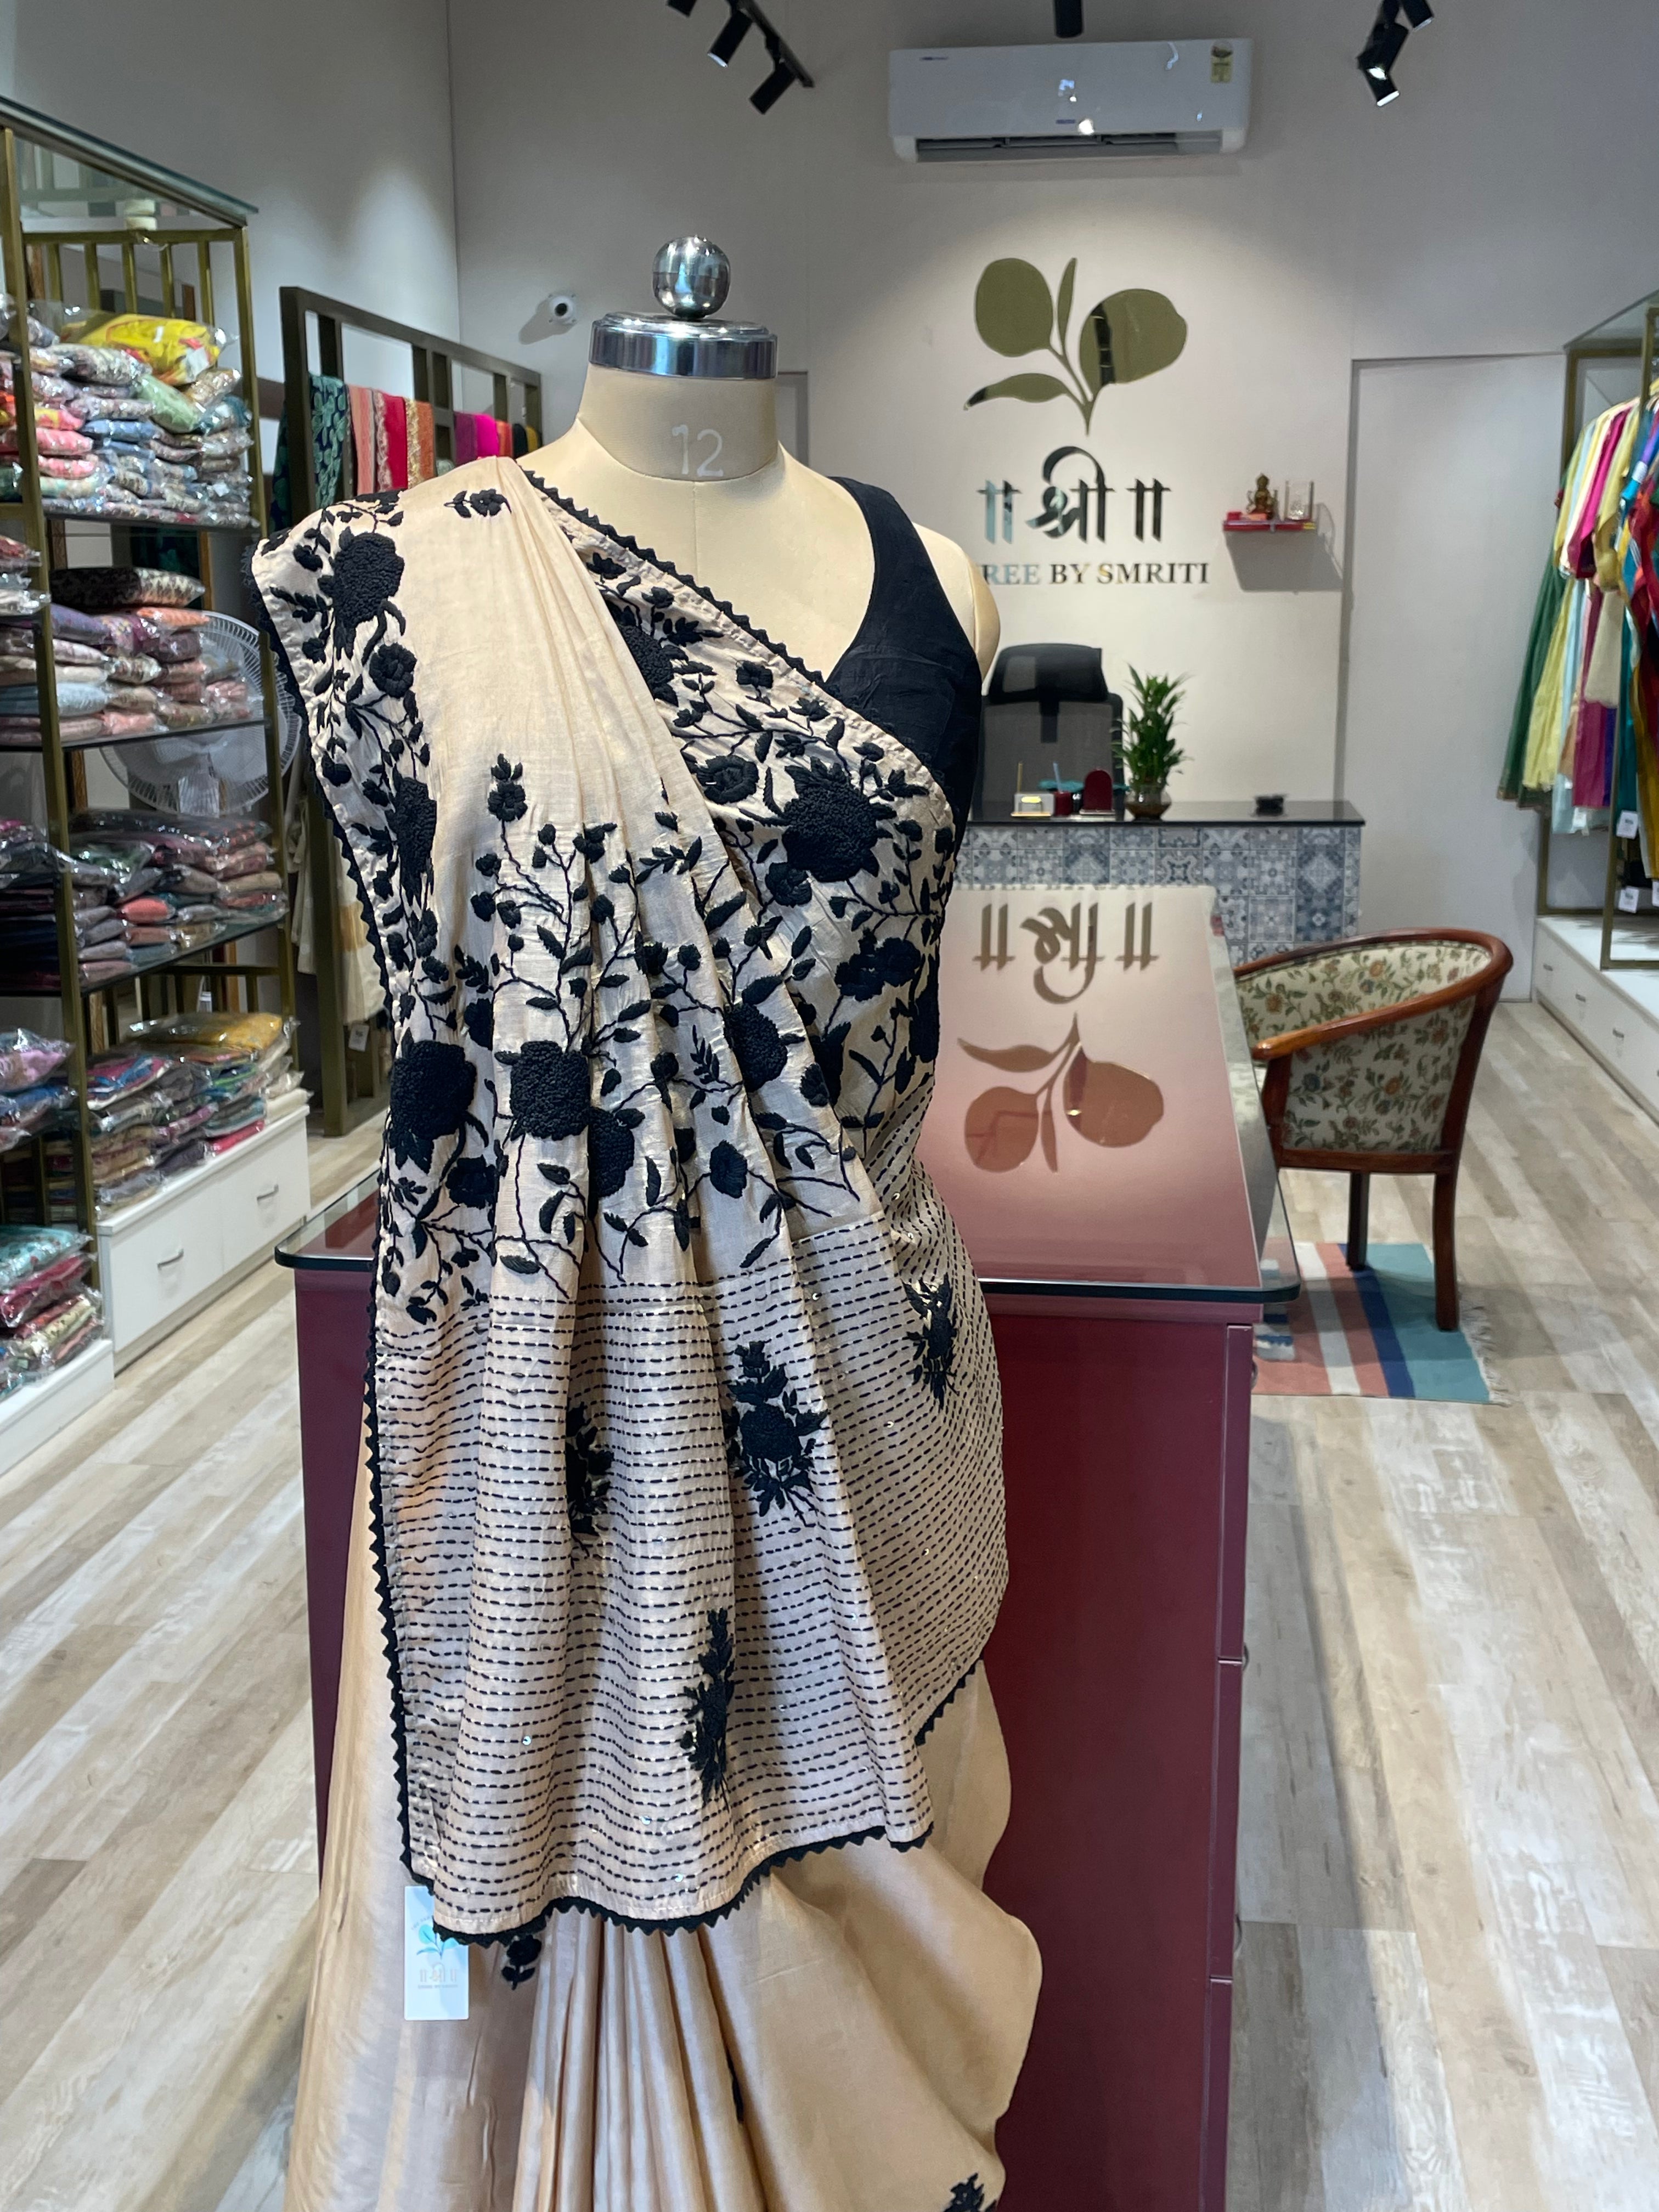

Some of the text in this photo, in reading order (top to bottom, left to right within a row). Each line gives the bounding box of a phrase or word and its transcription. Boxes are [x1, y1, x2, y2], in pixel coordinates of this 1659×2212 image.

[672, 424, 724, 477] 12
[1025, 445, 1115, 543] श्री
[977, 562, 1209, 585] REE BY SMRITI
